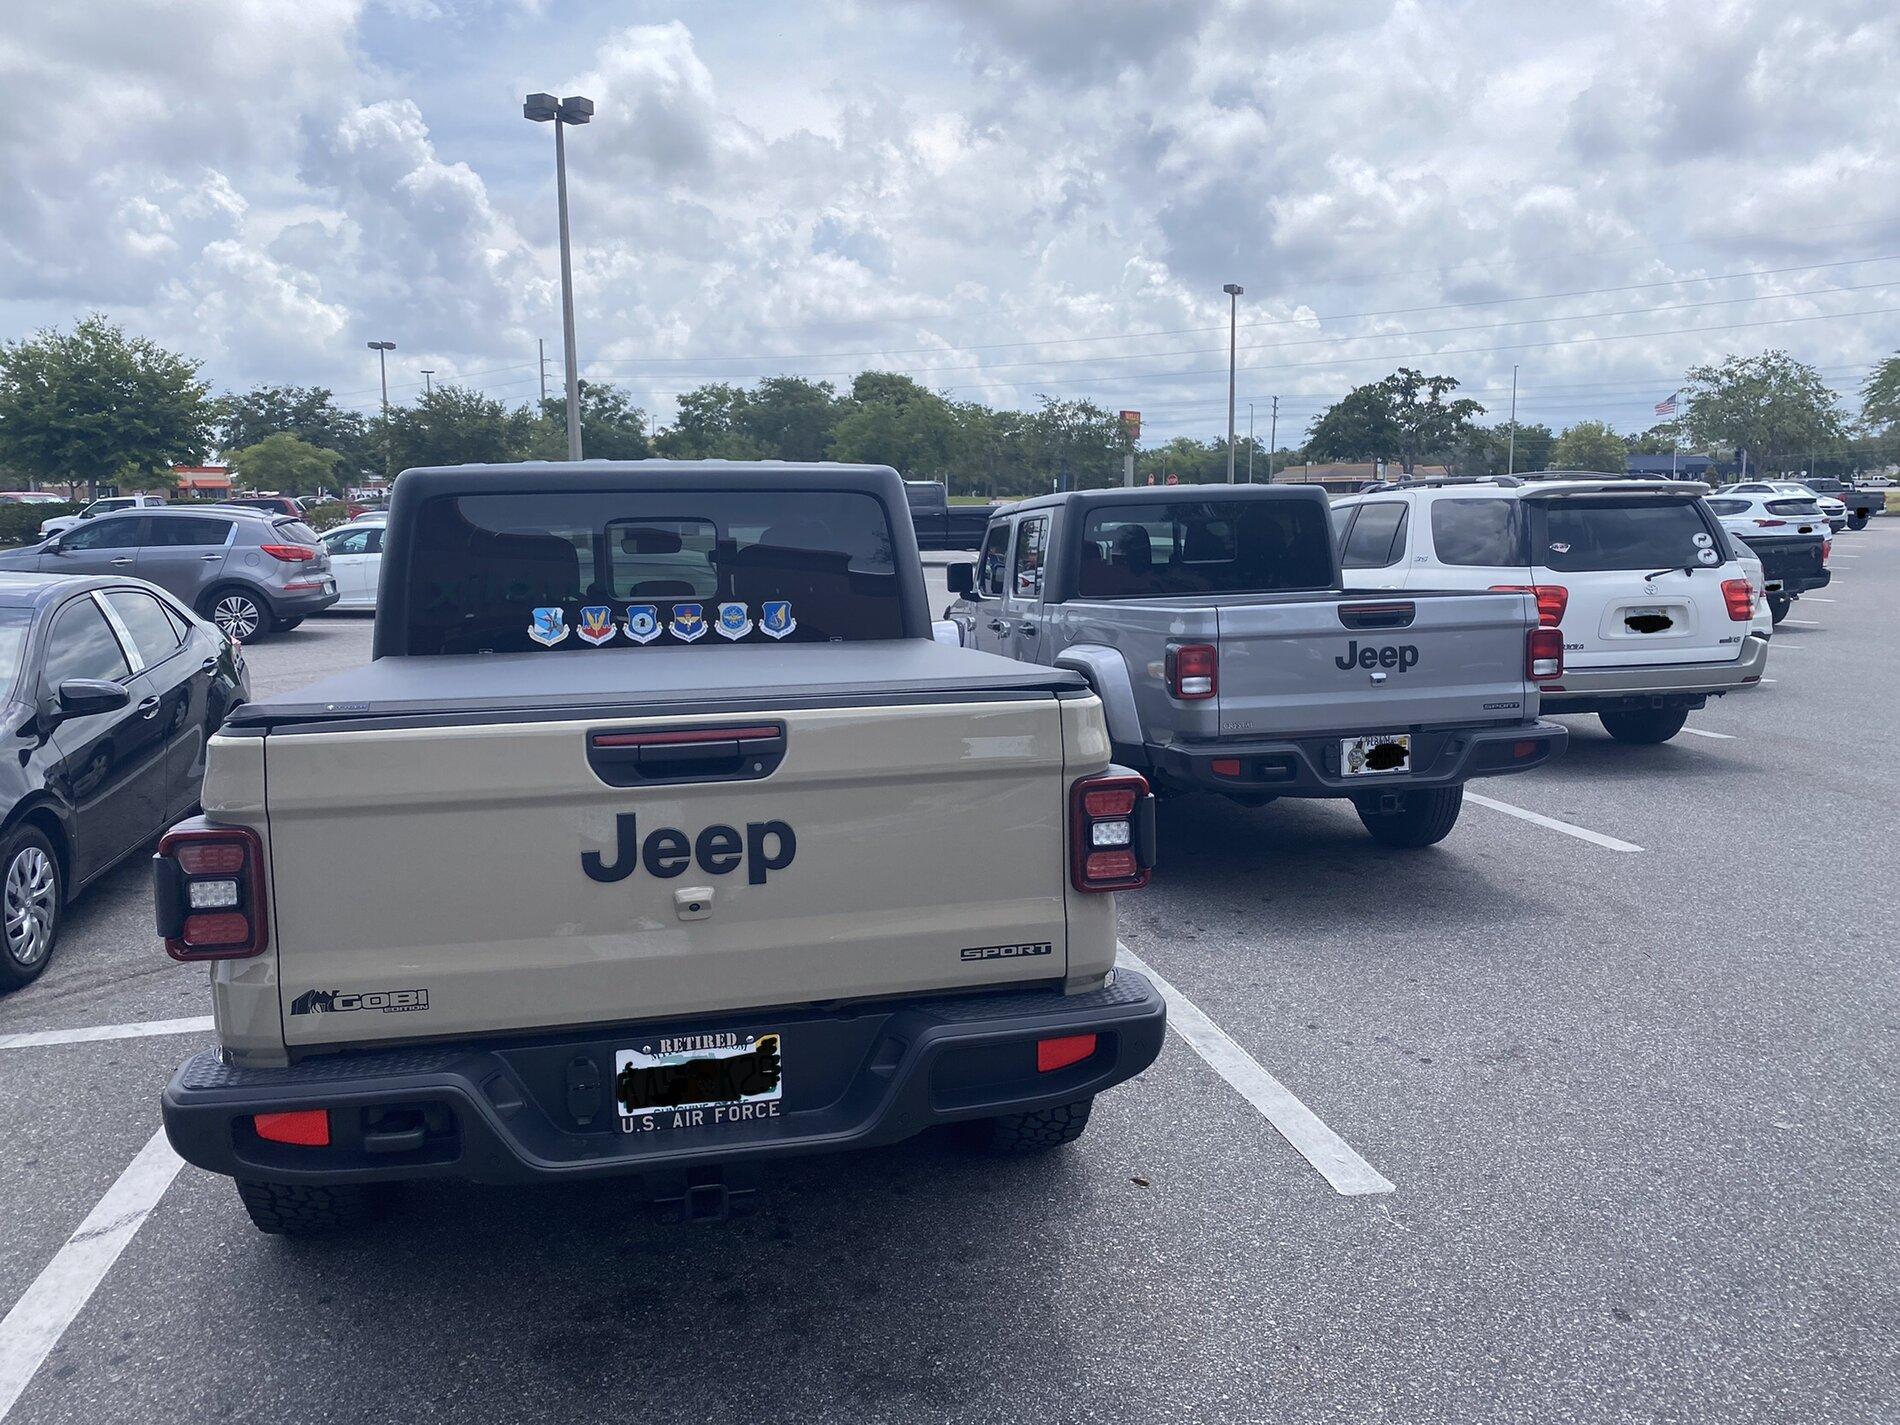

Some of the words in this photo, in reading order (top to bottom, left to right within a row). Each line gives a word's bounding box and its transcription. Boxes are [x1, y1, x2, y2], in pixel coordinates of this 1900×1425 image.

[1335, 640, 1419, 673] Jeep
[581, 812, 797, 885] Jeep
[961, 942, 1052, 960] SPORT
[332, 989, 428, 1011] GOBI
[383, 1004, 429, 1013] EDITION
[659, 1032, 738, 1053] RETIRED
[621, 1116, 661, 1134] U.S.
[672, 1110, 704, 1129] AIR
[715, 1101, 781, 1124] FORCE
